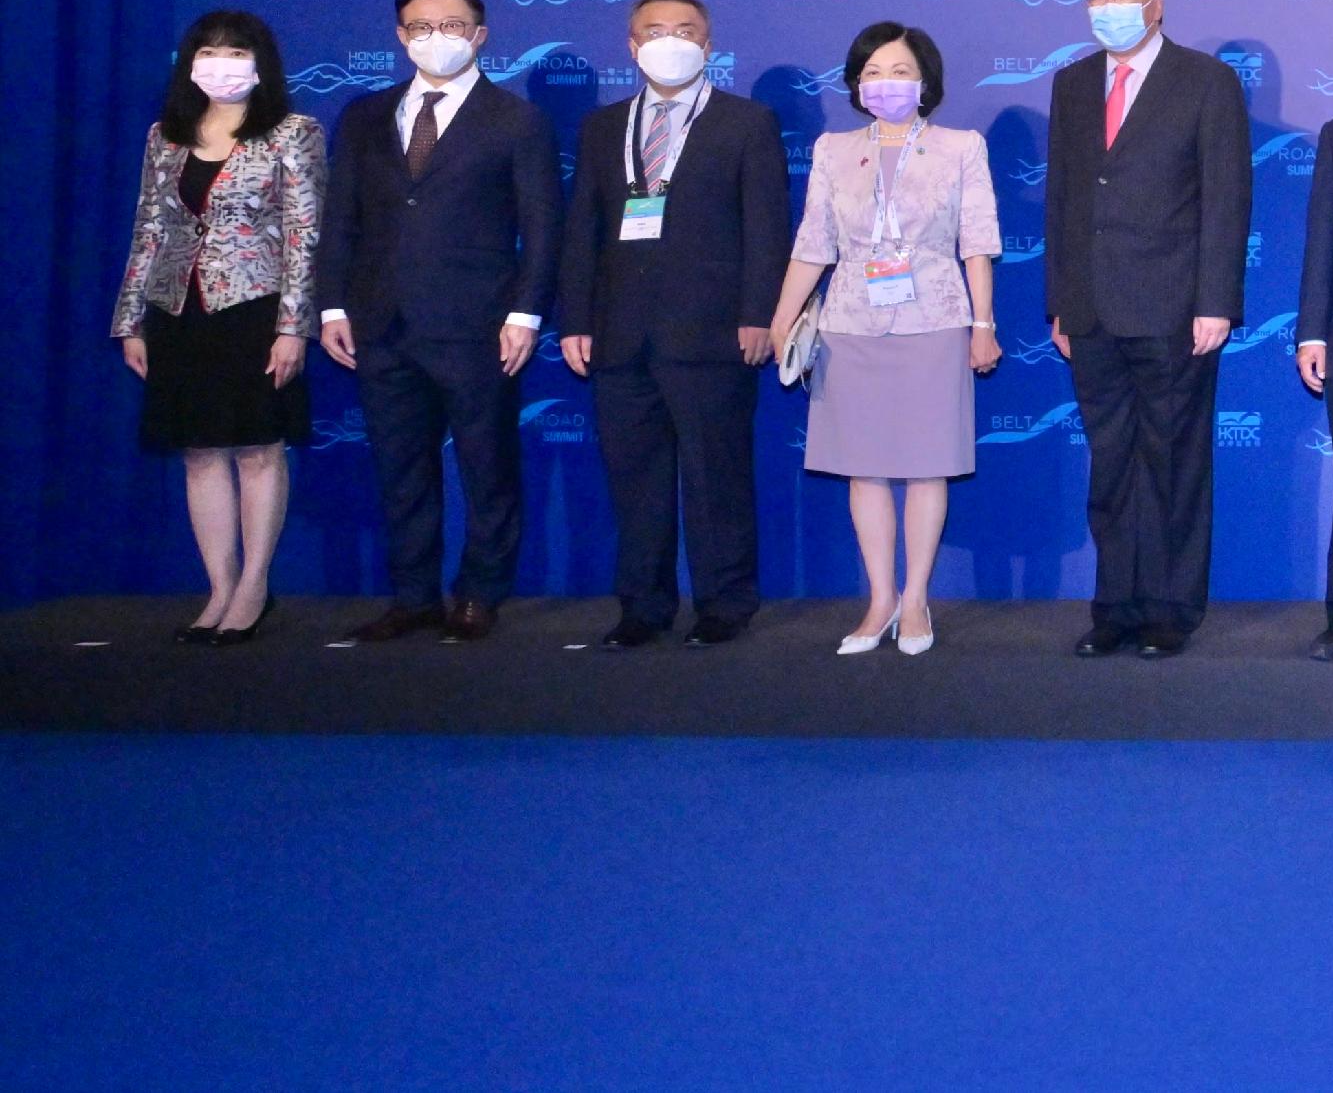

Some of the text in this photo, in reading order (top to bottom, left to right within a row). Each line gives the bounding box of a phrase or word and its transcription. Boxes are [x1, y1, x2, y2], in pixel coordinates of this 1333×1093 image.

[477, 57, 588, 70] ELT ROAD
[994, 58, 1035, 70] BELT
[546, 74, 588, 85] SUMMIT
[1279, 148, 1316, 160] ROA
[534, 414, 584, 427] ROAD
[992, 416, 1031, 428] BELT
